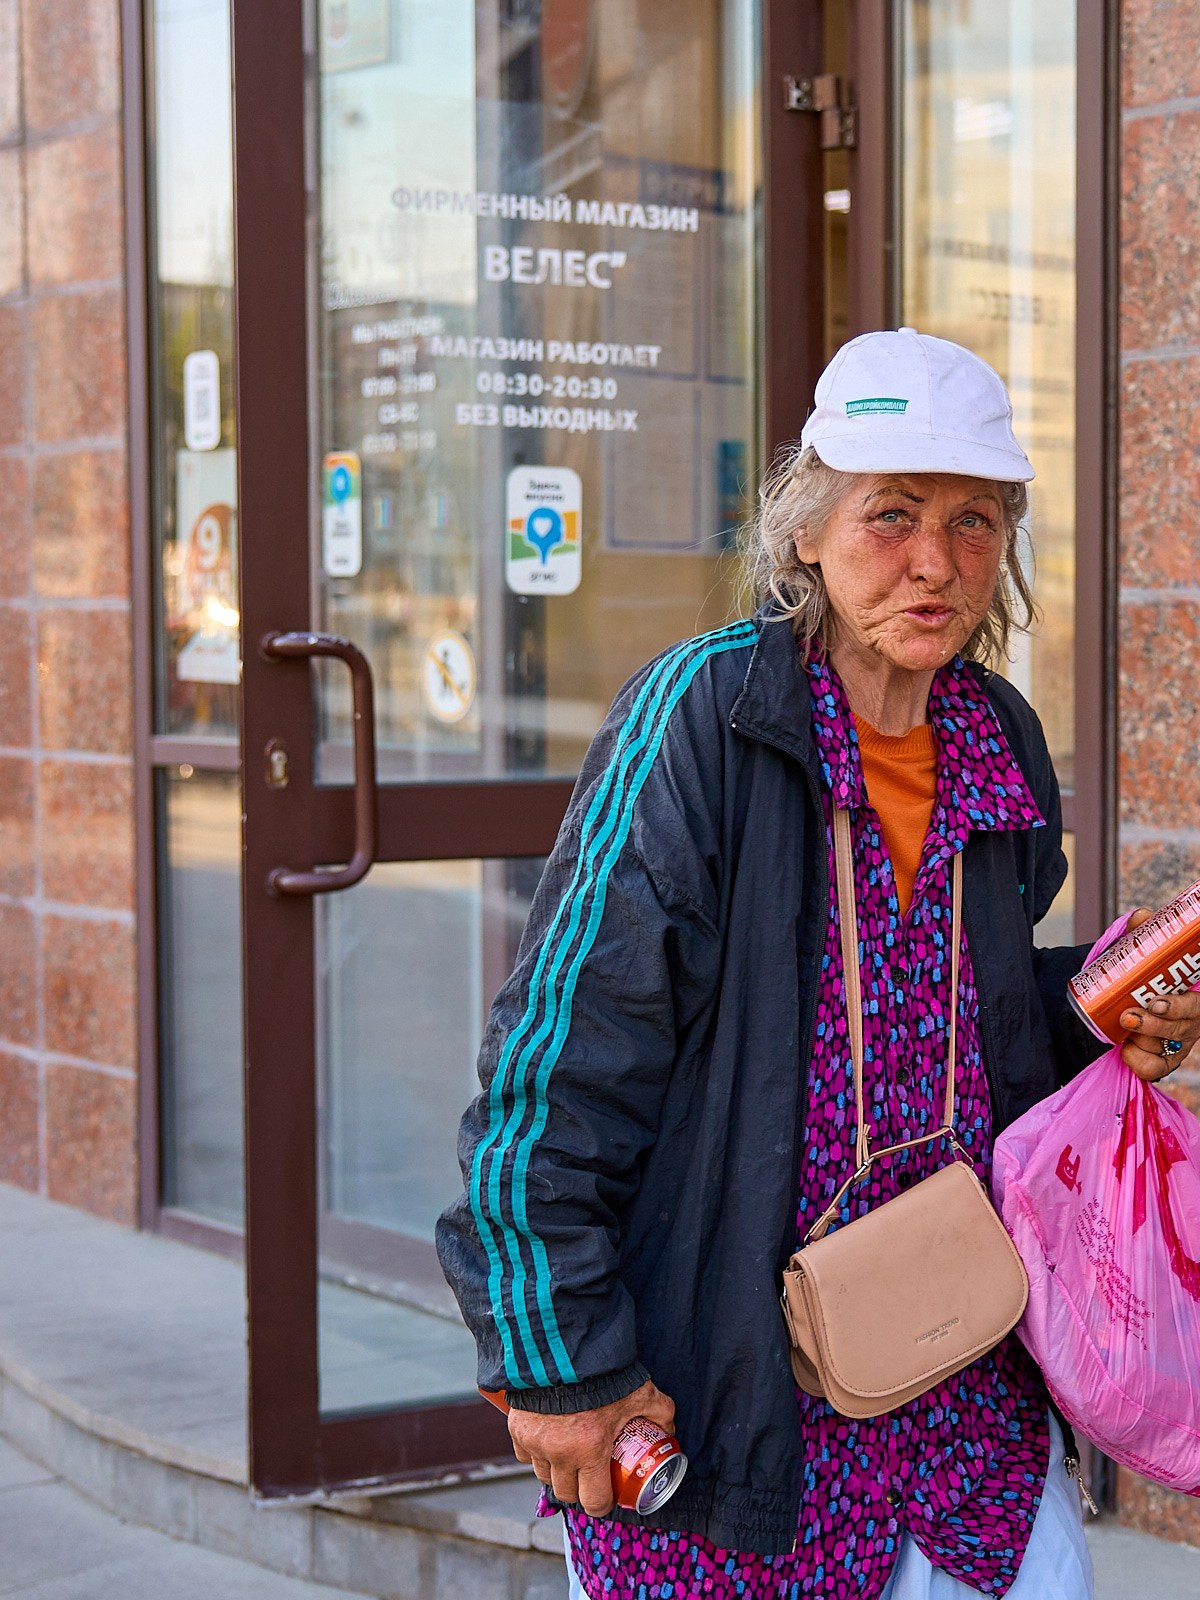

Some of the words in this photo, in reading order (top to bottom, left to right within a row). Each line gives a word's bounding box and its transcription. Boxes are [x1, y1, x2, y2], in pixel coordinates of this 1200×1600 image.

[391, 186, 571, 224] ФИРМЕННЫЙ
[576, 199, 699, 233] МАГАЗИН
[429, 335, 543, 362] МАГАЗИН
[547, 339, 661, 368] РАБОТАЕТ
[476, 371, 618, 400] 08:30-20:30
[455, 404, 498, 428] БЕЗ
[502, 404, 639, 434] ВЫХОДНЫХ
